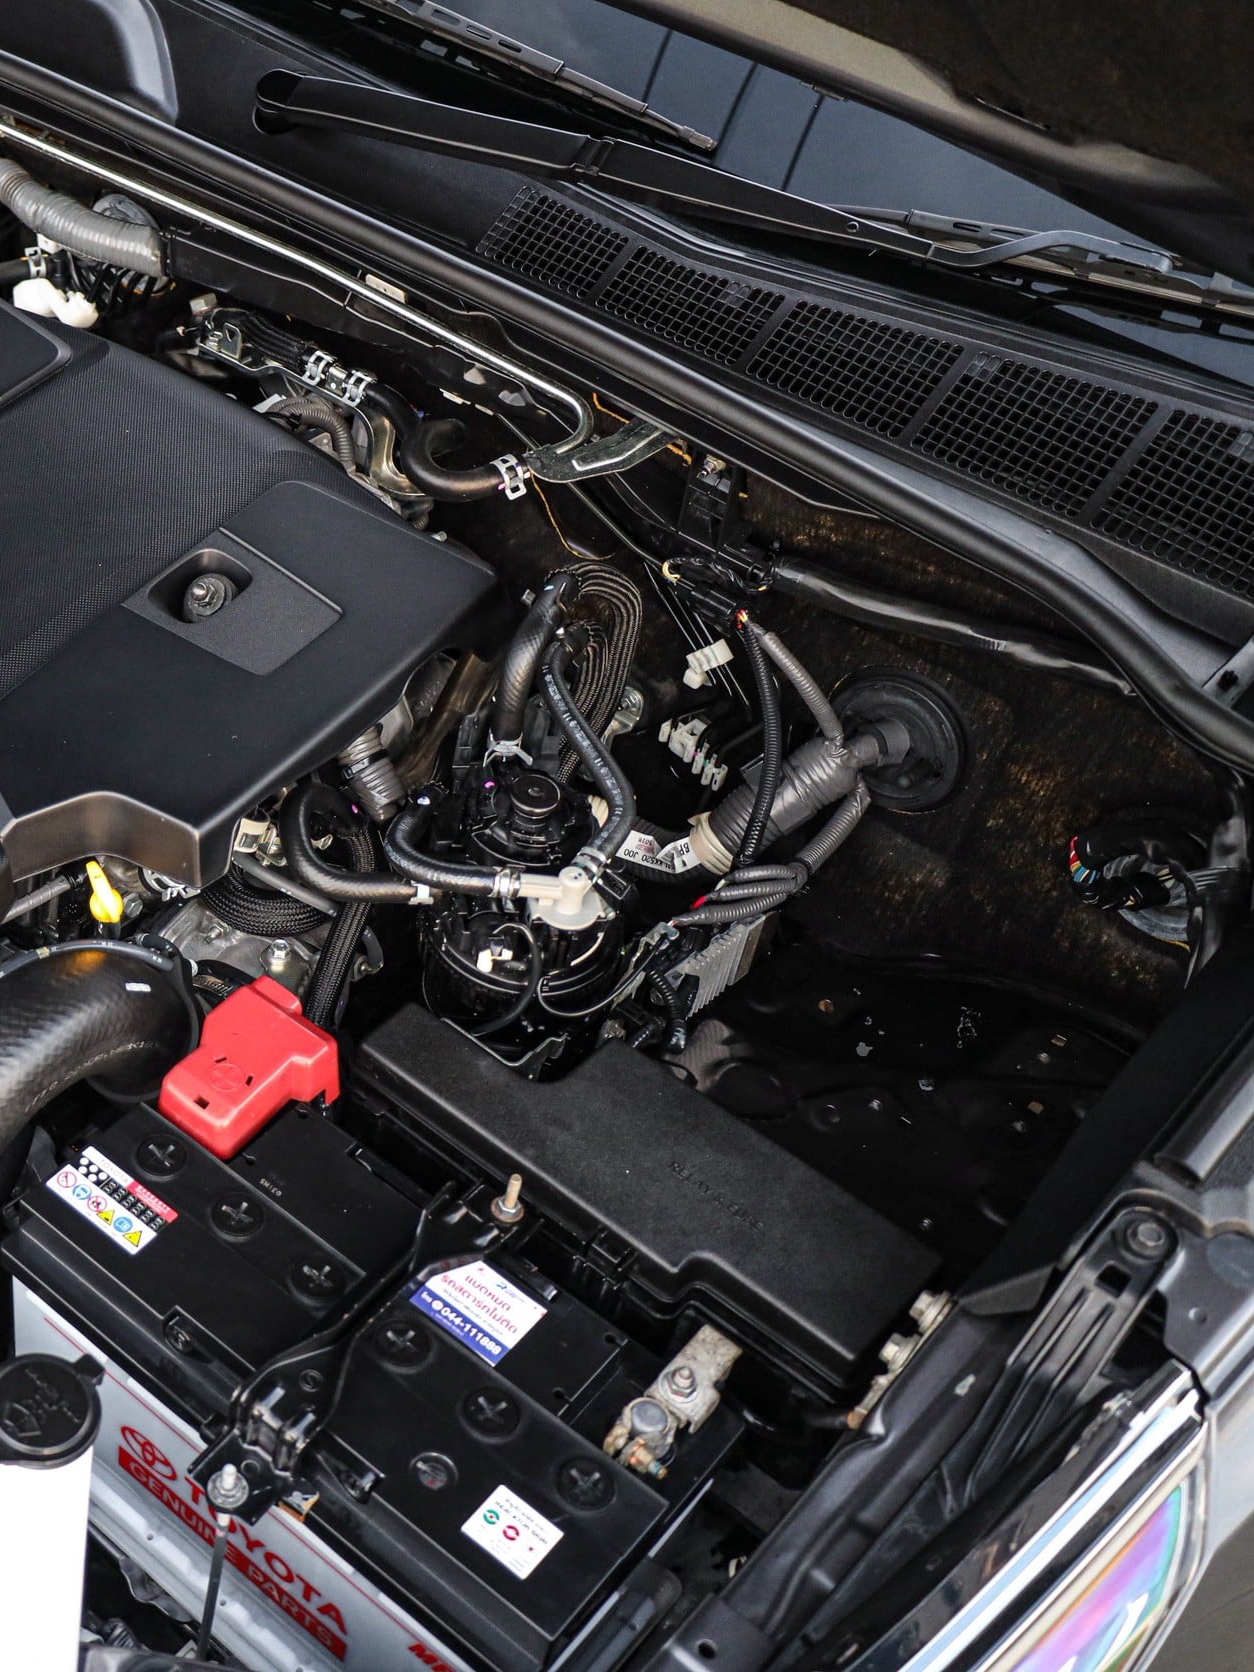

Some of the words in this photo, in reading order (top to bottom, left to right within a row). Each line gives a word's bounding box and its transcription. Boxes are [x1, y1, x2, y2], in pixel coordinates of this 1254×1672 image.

[98, 1158, 129, 1184] TOYOTA
[439, 1305, 502, 1356] 044-111888
[246, 1563, 335, 1646] PARTS
